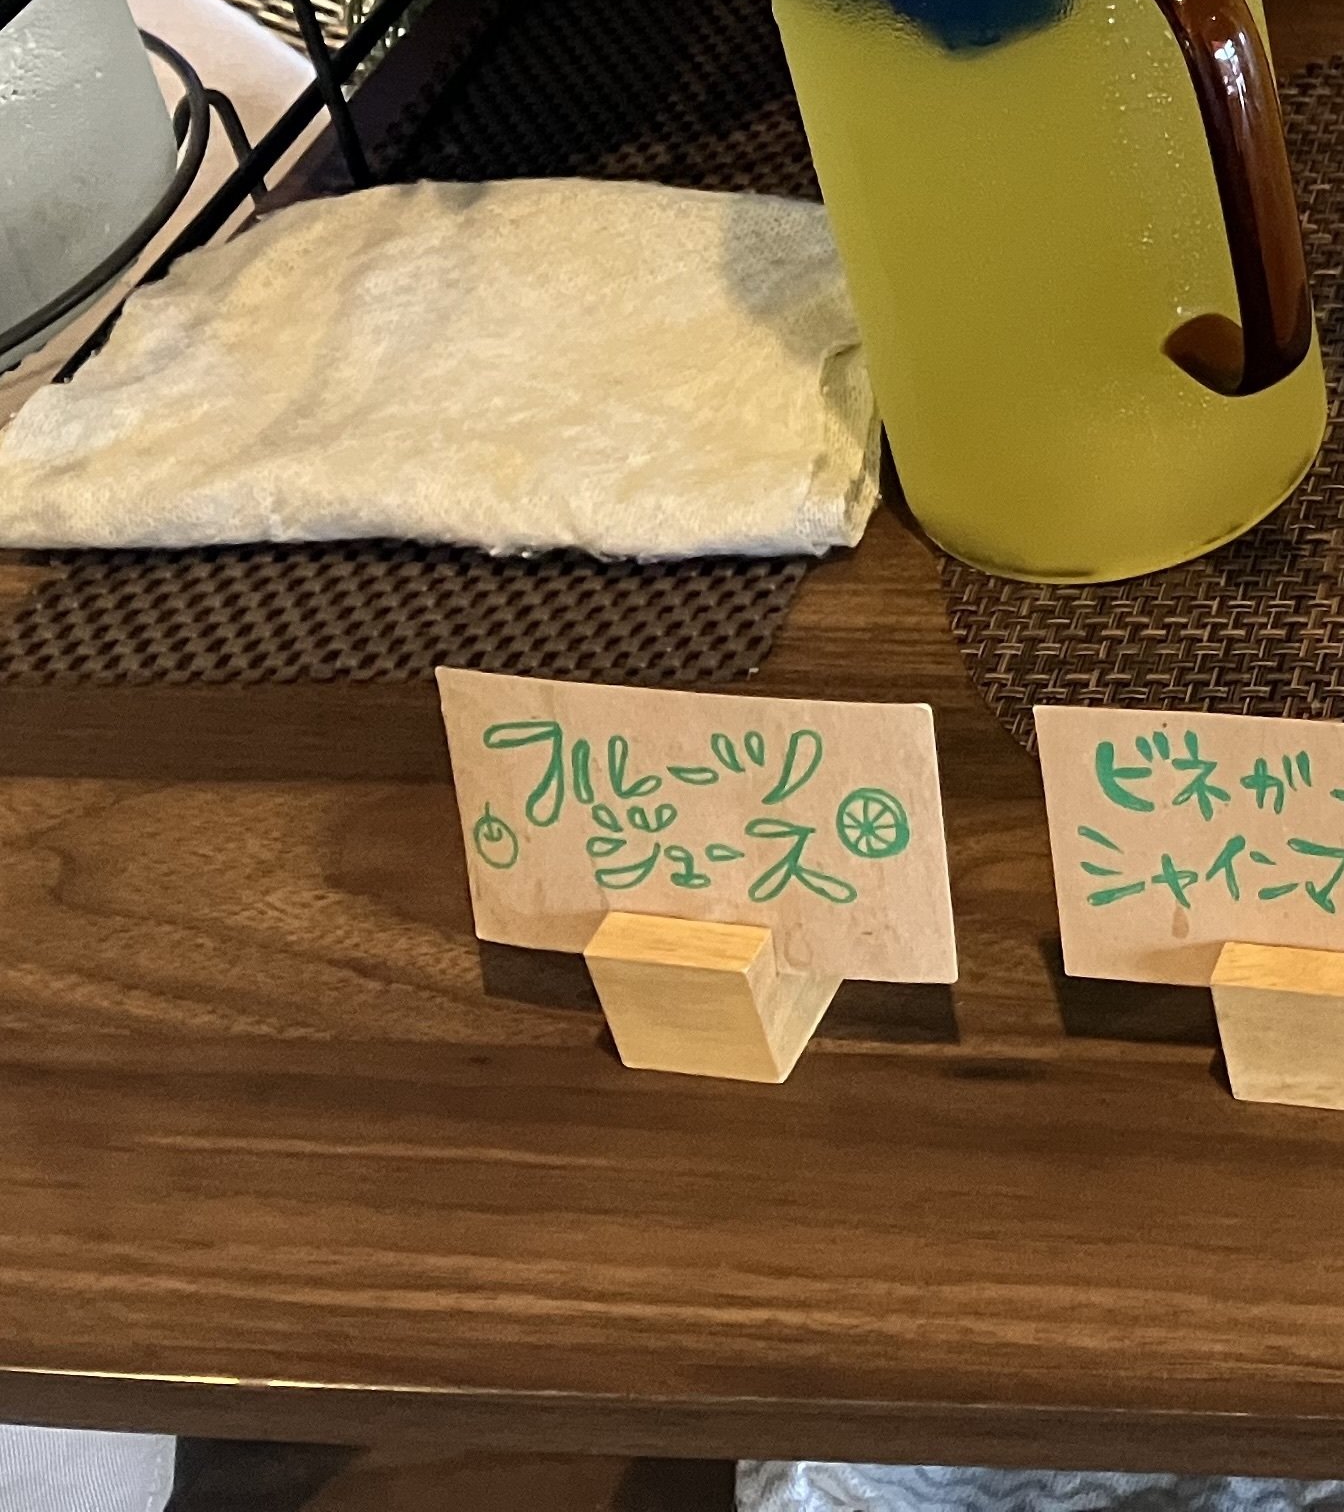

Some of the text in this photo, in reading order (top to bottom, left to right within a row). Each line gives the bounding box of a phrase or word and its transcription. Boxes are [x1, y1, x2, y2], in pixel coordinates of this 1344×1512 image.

[484, 721, 823, 828] フルーツ
[586, 802, 858, 904] ジュース
